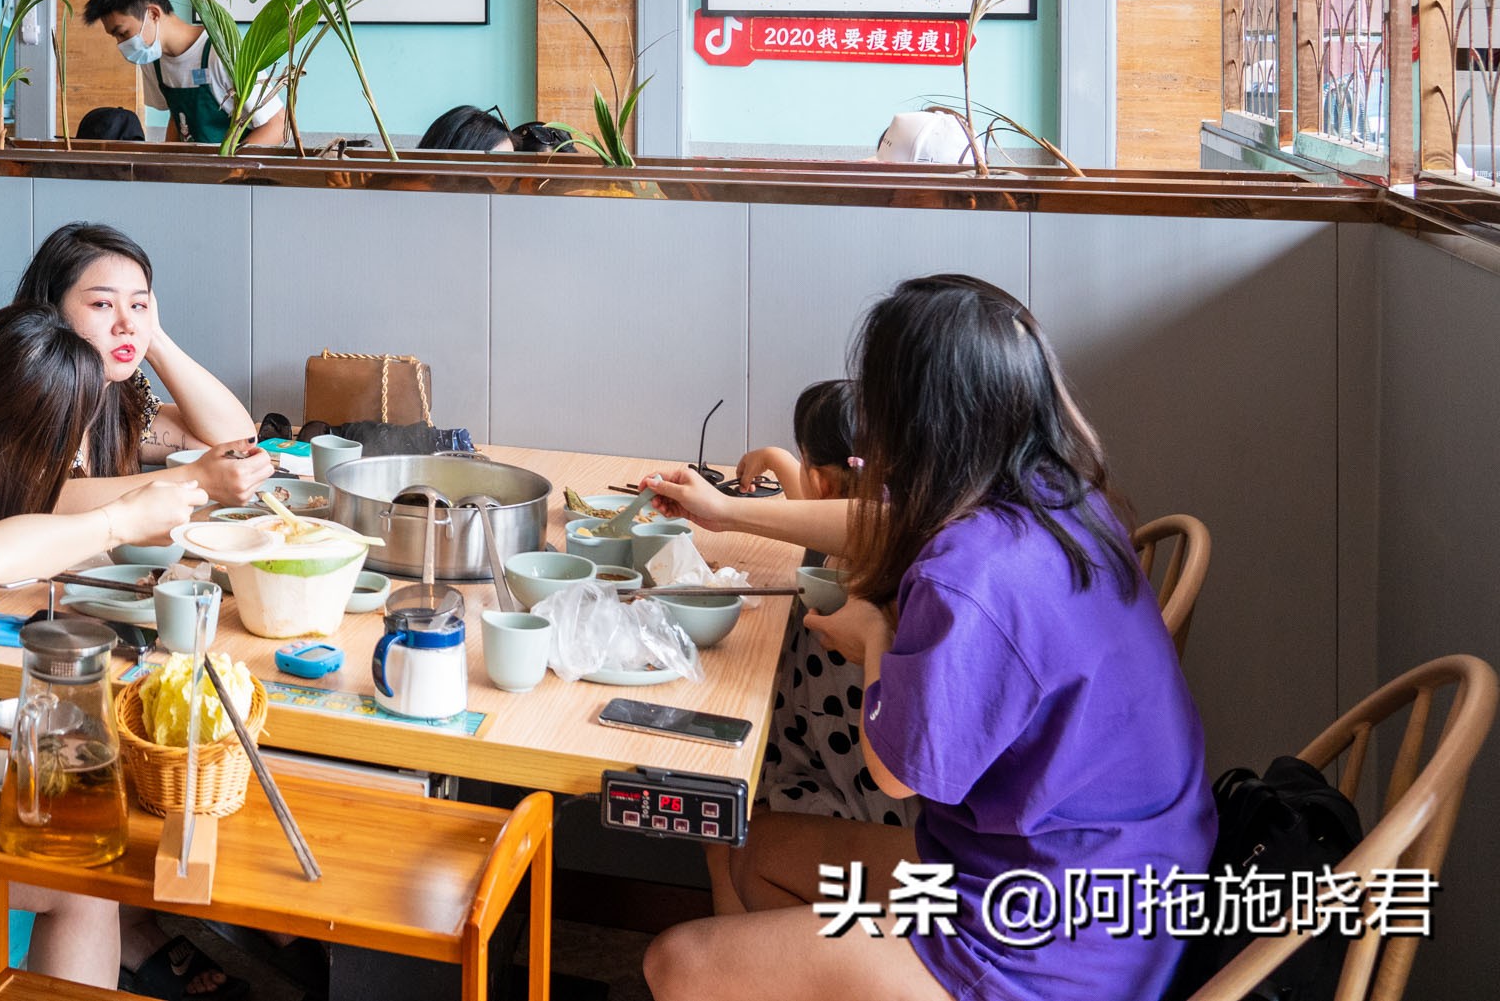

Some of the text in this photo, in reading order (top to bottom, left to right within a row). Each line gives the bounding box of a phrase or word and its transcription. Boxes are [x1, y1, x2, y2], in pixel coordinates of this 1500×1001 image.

[764, 27, 950, 53] 2020我要瘦瘦瘦!
[660, 796, 681, 812] P6
